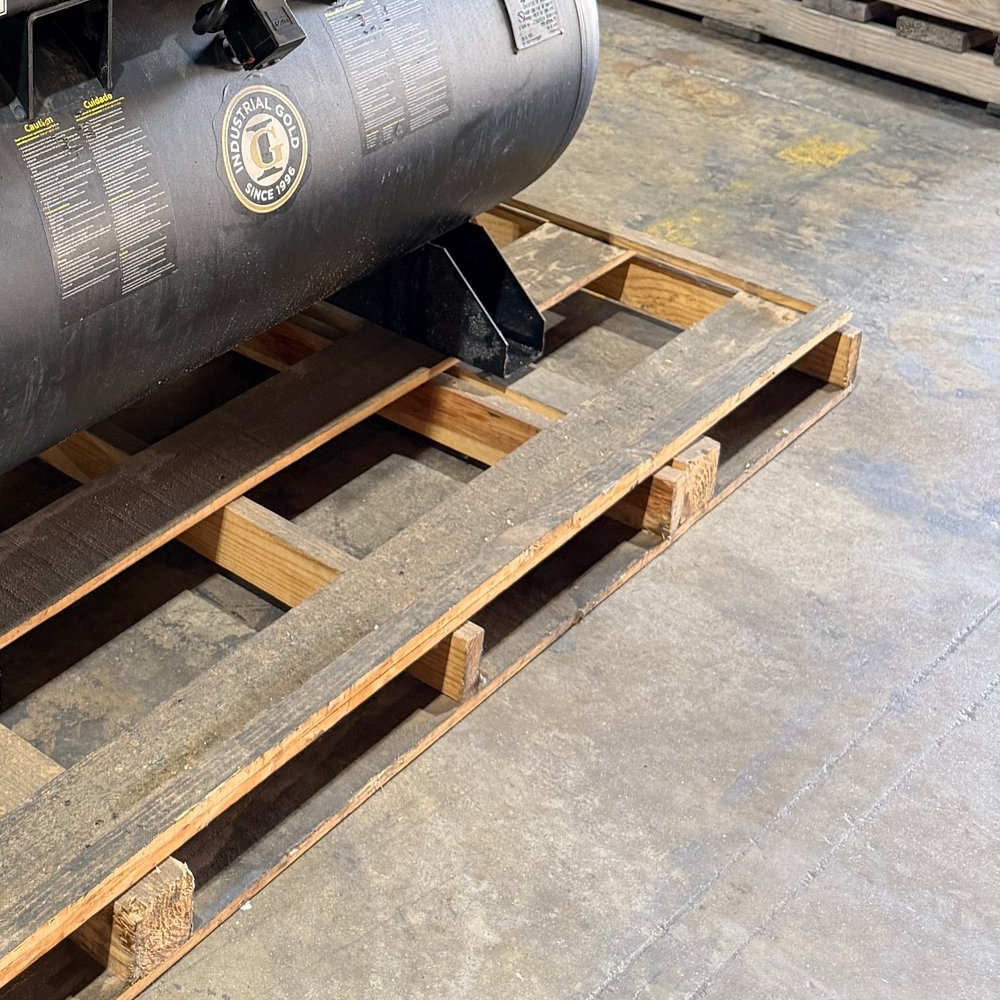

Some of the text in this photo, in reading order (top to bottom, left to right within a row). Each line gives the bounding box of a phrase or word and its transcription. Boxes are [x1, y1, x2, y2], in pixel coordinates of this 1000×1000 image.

[83, 92, 113, 109] Cuidado
[230, 96, 300, 175] INDUSTRIAL GOLD
[244, 165, 296, 202] SINCE 1996
